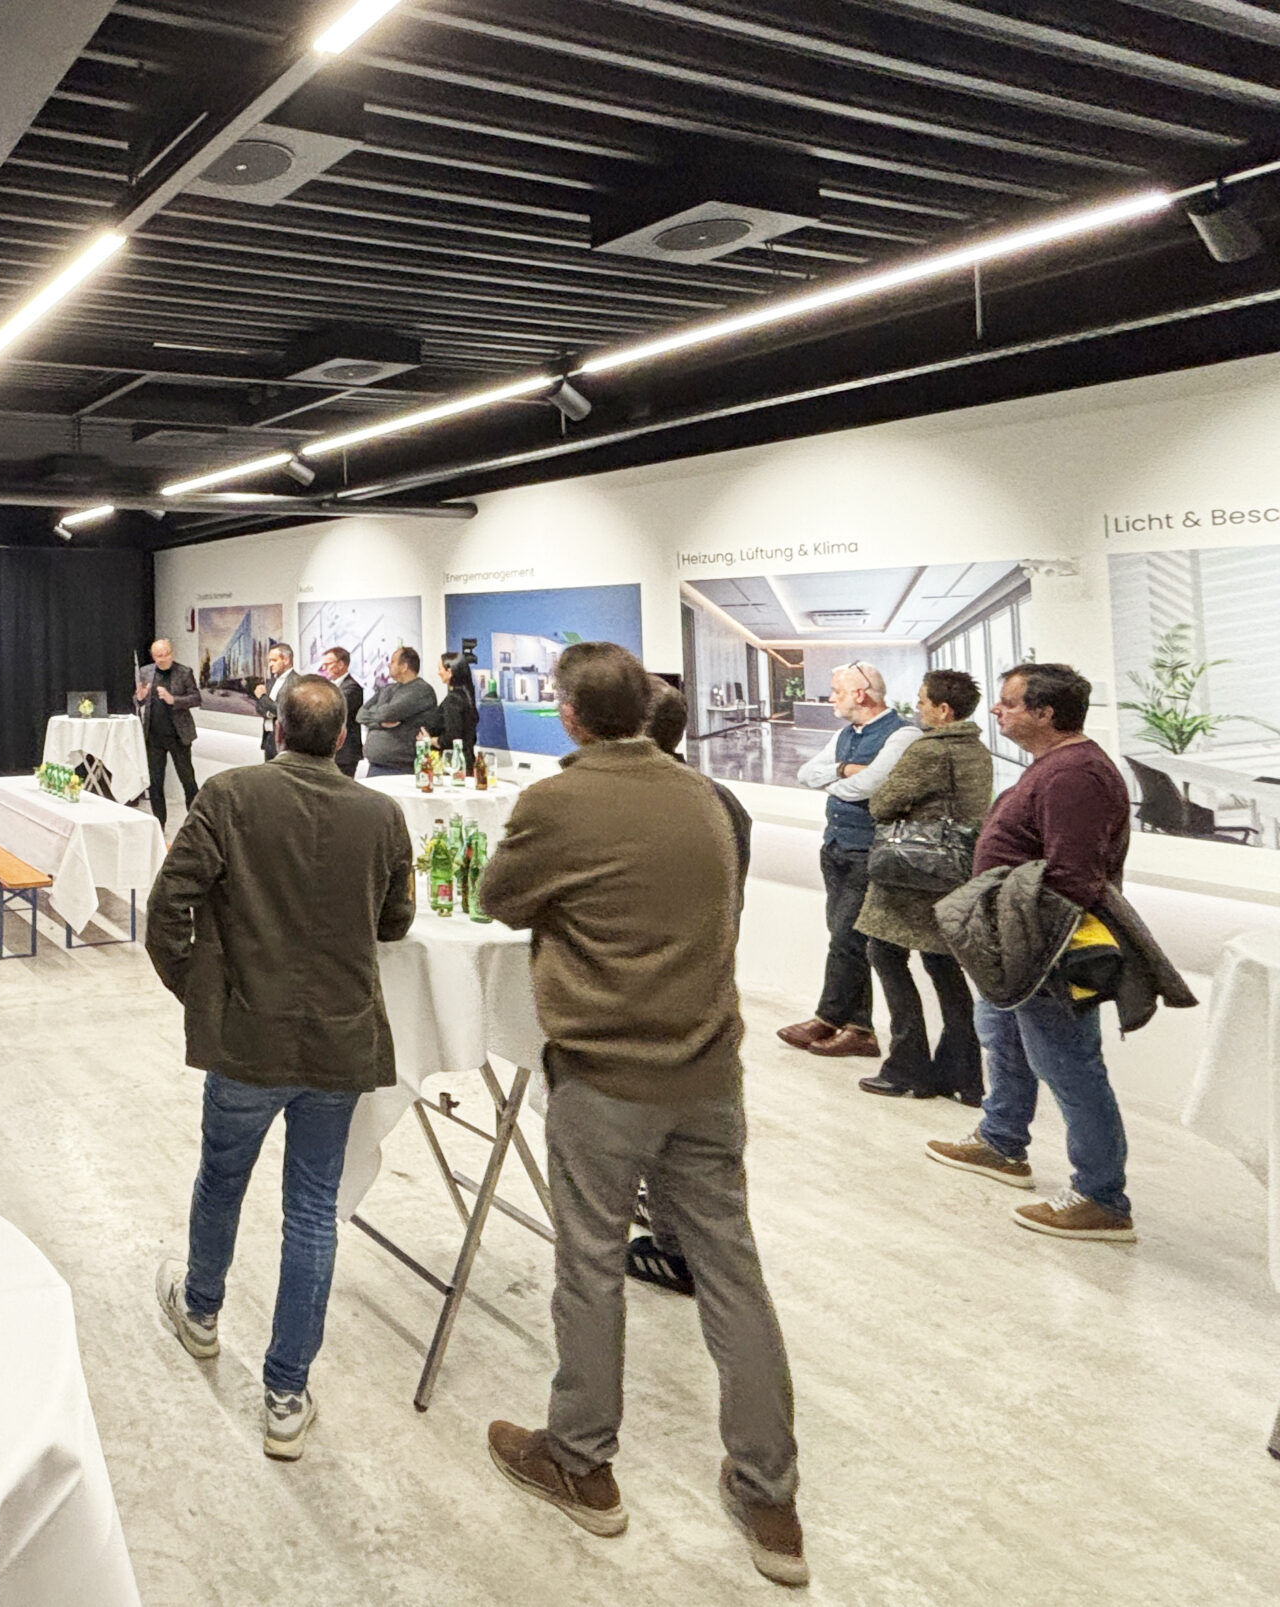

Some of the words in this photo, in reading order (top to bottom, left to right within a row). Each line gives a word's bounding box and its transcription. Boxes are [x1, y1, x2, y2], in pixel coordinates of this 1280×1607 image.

[1114, 513, 1174, 533] Licht
[1182, 511, 1201, 528] &
[681, 551, 736, 567] Heizung,
[740, 546, 793, 562] Lüftung
[798, 543, 808, 557] &
[813, 541, 858, 556] Klima
